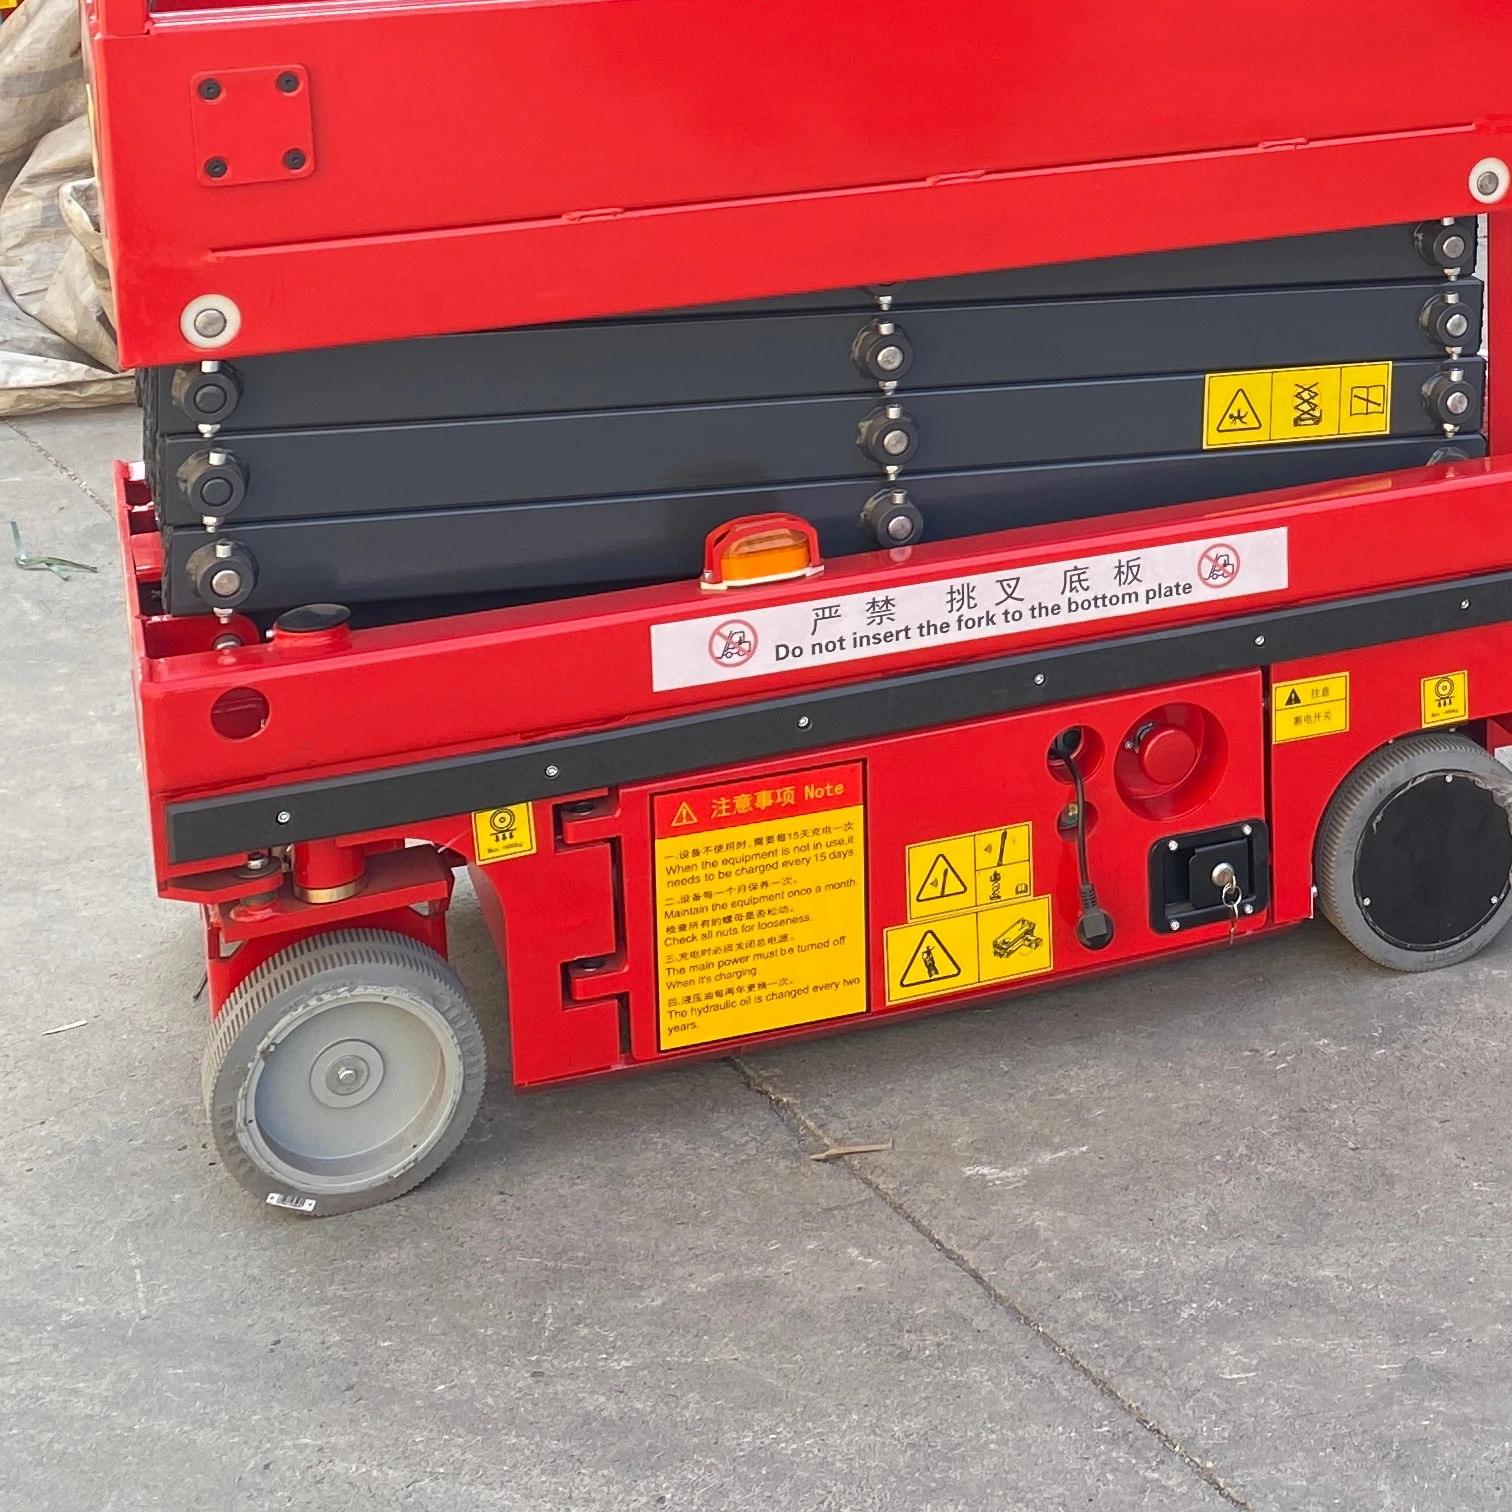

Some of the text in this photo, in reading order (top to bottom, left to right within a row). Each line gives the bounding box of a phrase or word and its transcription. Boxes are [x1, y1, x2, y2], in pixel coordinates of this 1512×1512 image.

[774, 581, 1193, 662] Do not insert the fork to the bottom plate
[1310, 686, 1331, 700] 注意
[1293, 710, 1332, 727] 断电开关
[711, 782, 844, 819] 注意事项 Note
